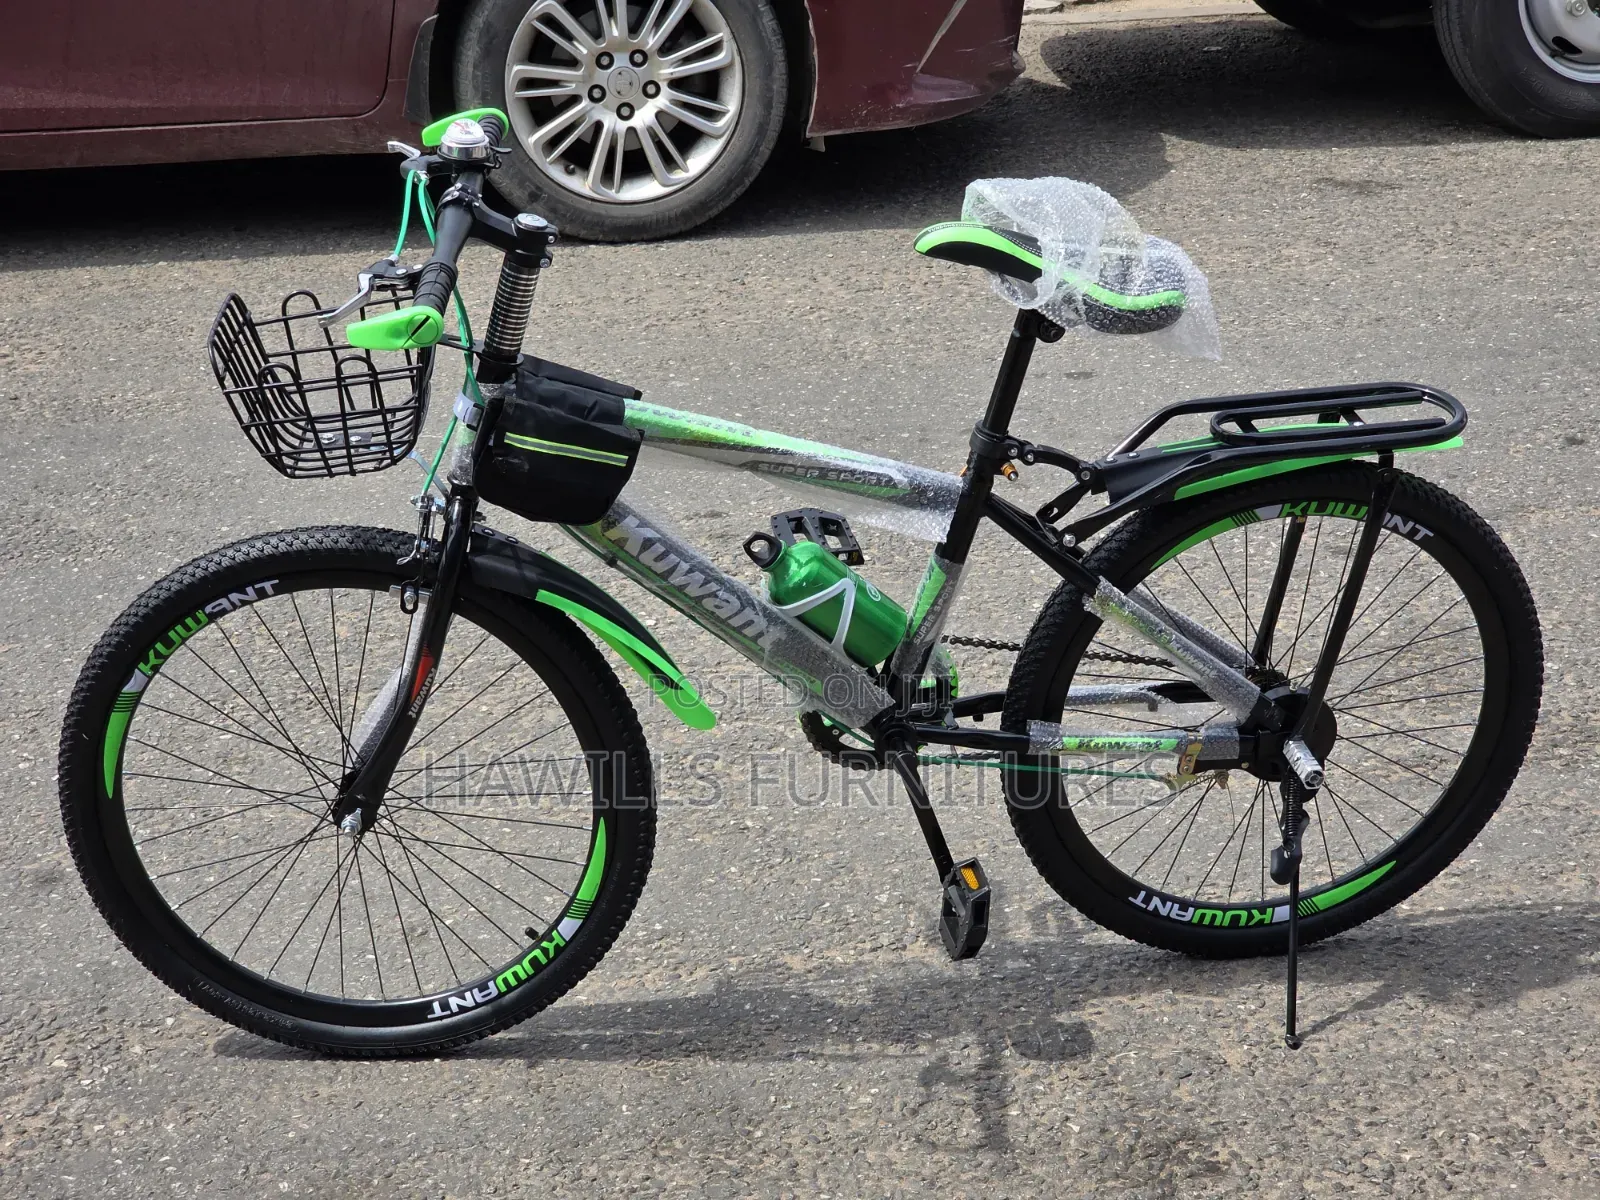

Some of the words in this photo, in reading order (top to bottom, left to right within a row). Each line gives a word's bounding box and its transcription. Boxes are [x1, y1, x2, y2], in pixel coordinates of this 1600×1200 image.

[758, 462, 820, 479] SUPER
[604, 514, 788, 649] Kuwant
[137, 578, 281, 676] KUWANT
[914, 615, 936, 645] SUPER
[1127, 889, 1274, 927] KUWANT
[426, 929, 567, 1020] KUWANT
